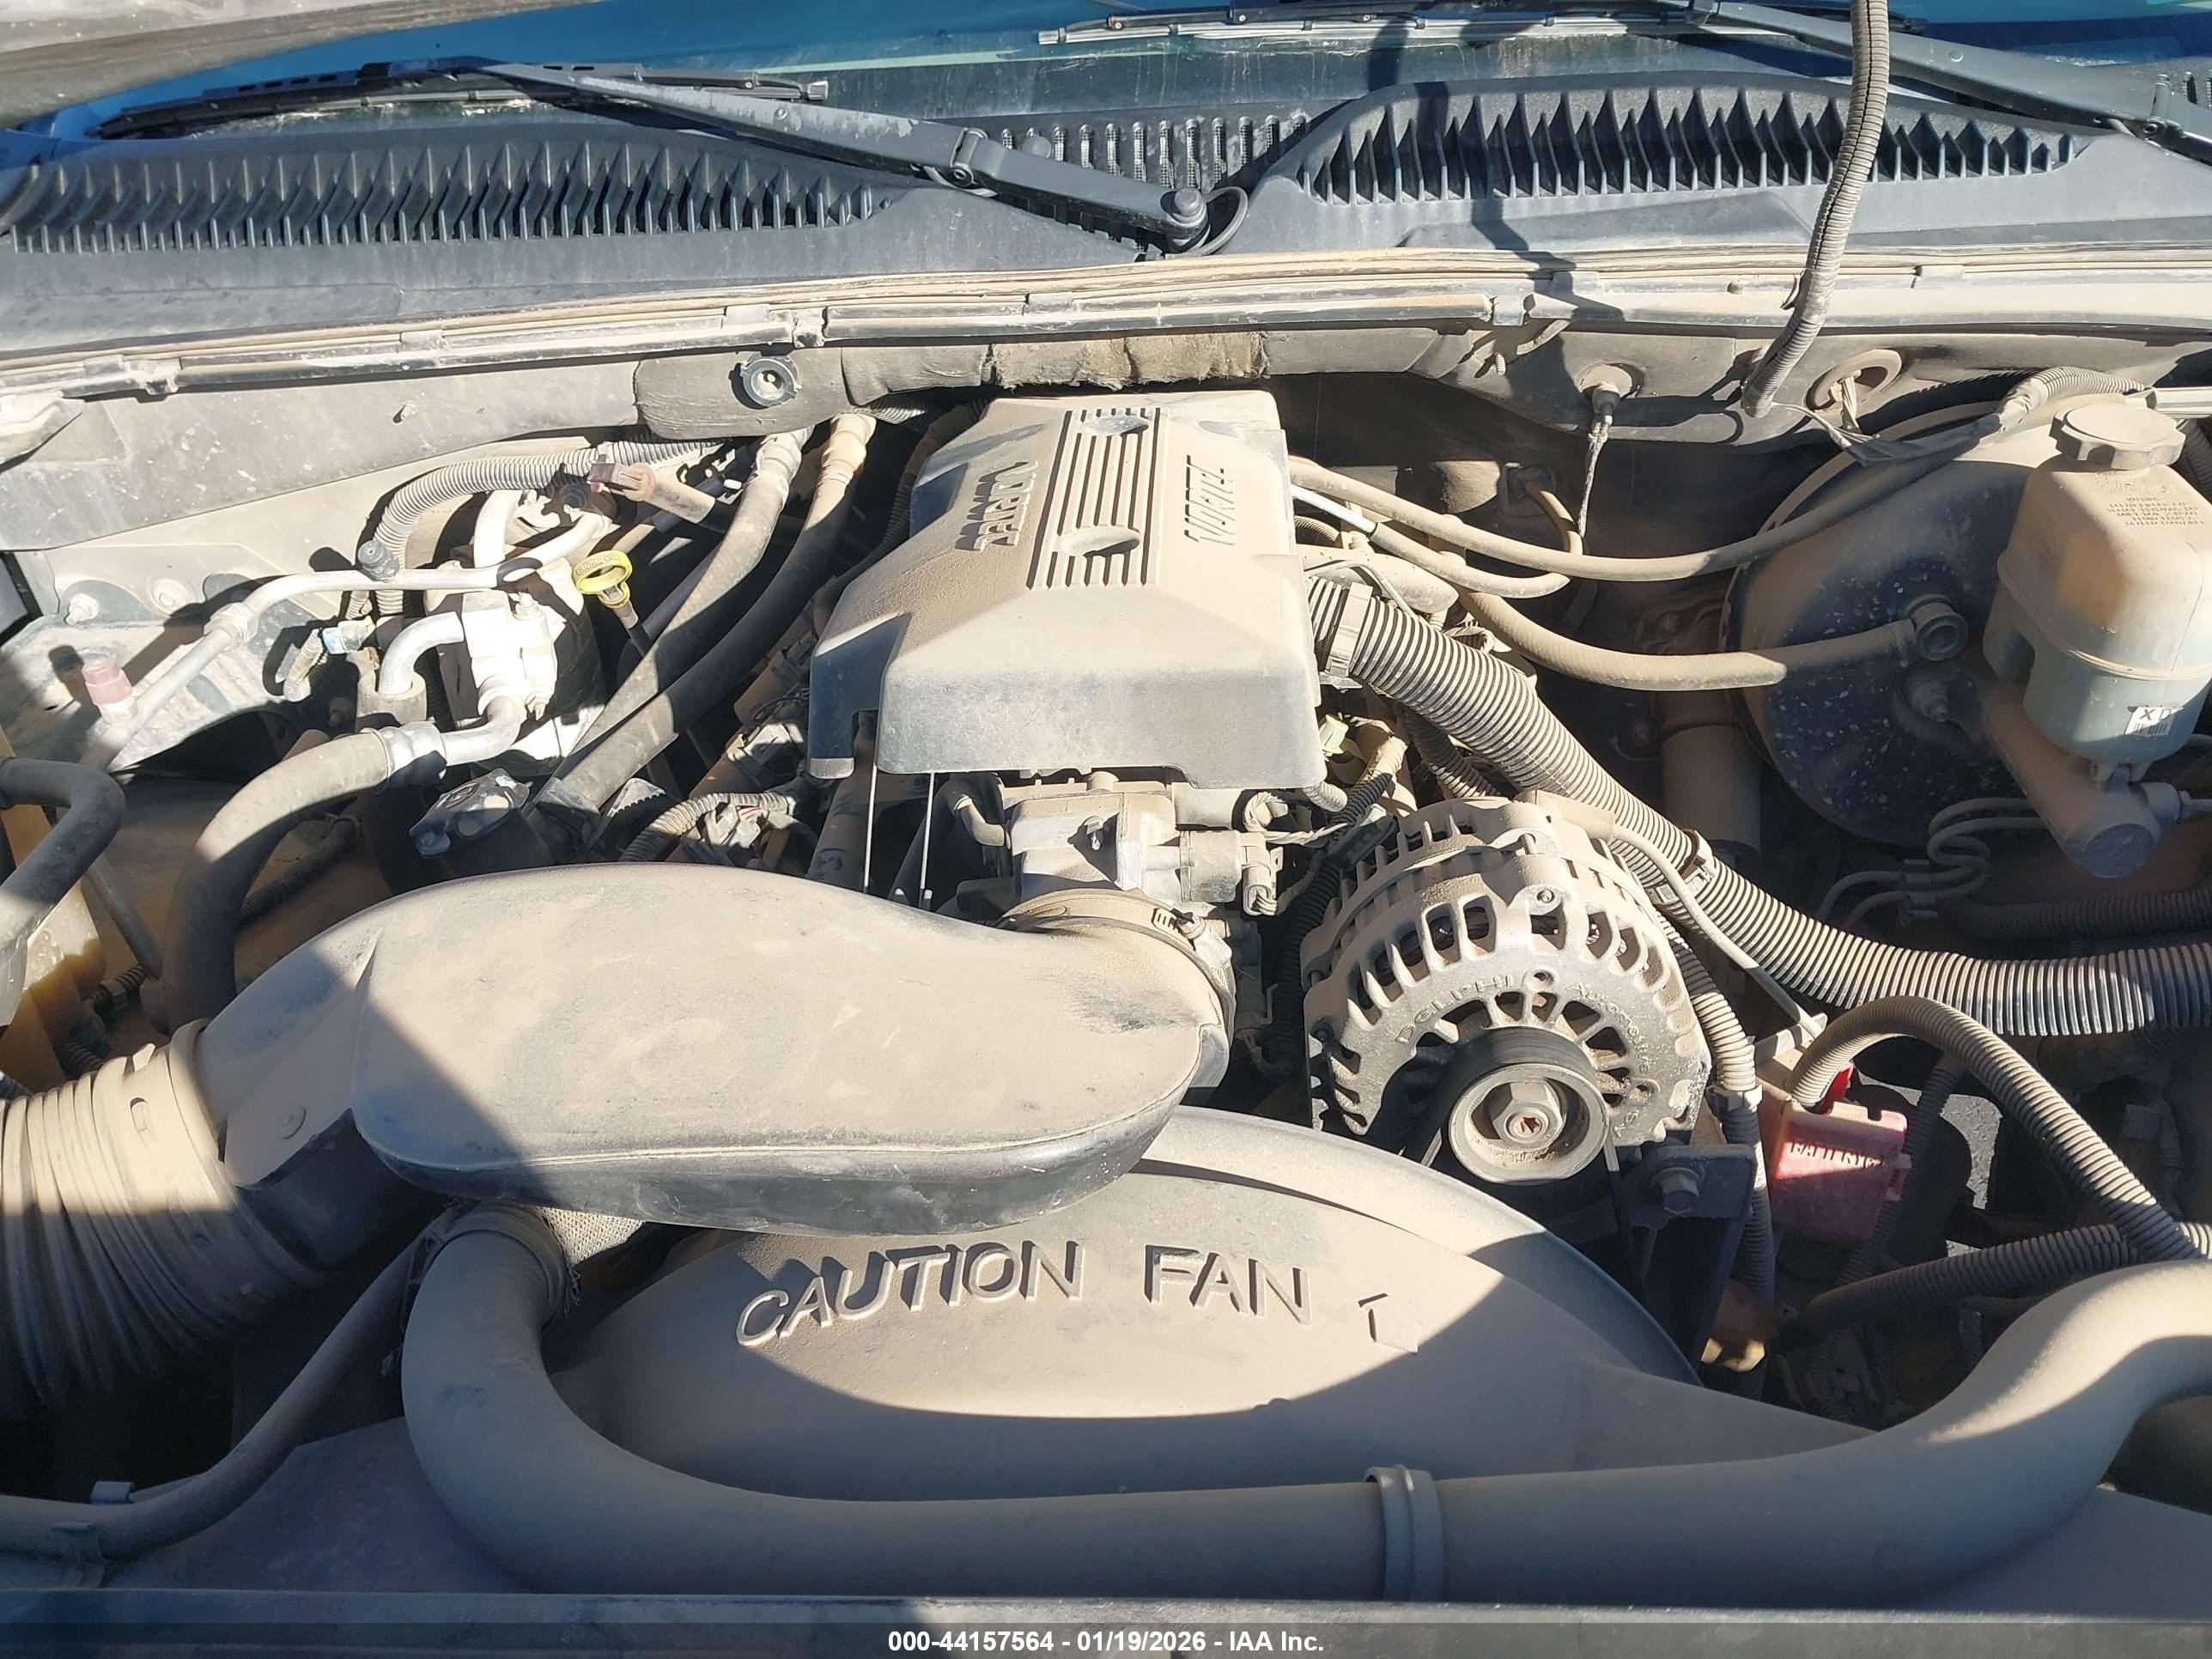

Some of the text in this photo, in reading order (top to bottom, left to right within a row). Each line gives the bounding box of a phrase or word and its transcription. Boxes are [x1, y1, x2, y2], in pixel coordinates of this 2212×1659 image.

[963, 459, 1039, 552] VORTEC
[1395, 975, 1514, 1046] DELPHI
[736, 1241, 1312, 1346] CAUTION FAN
